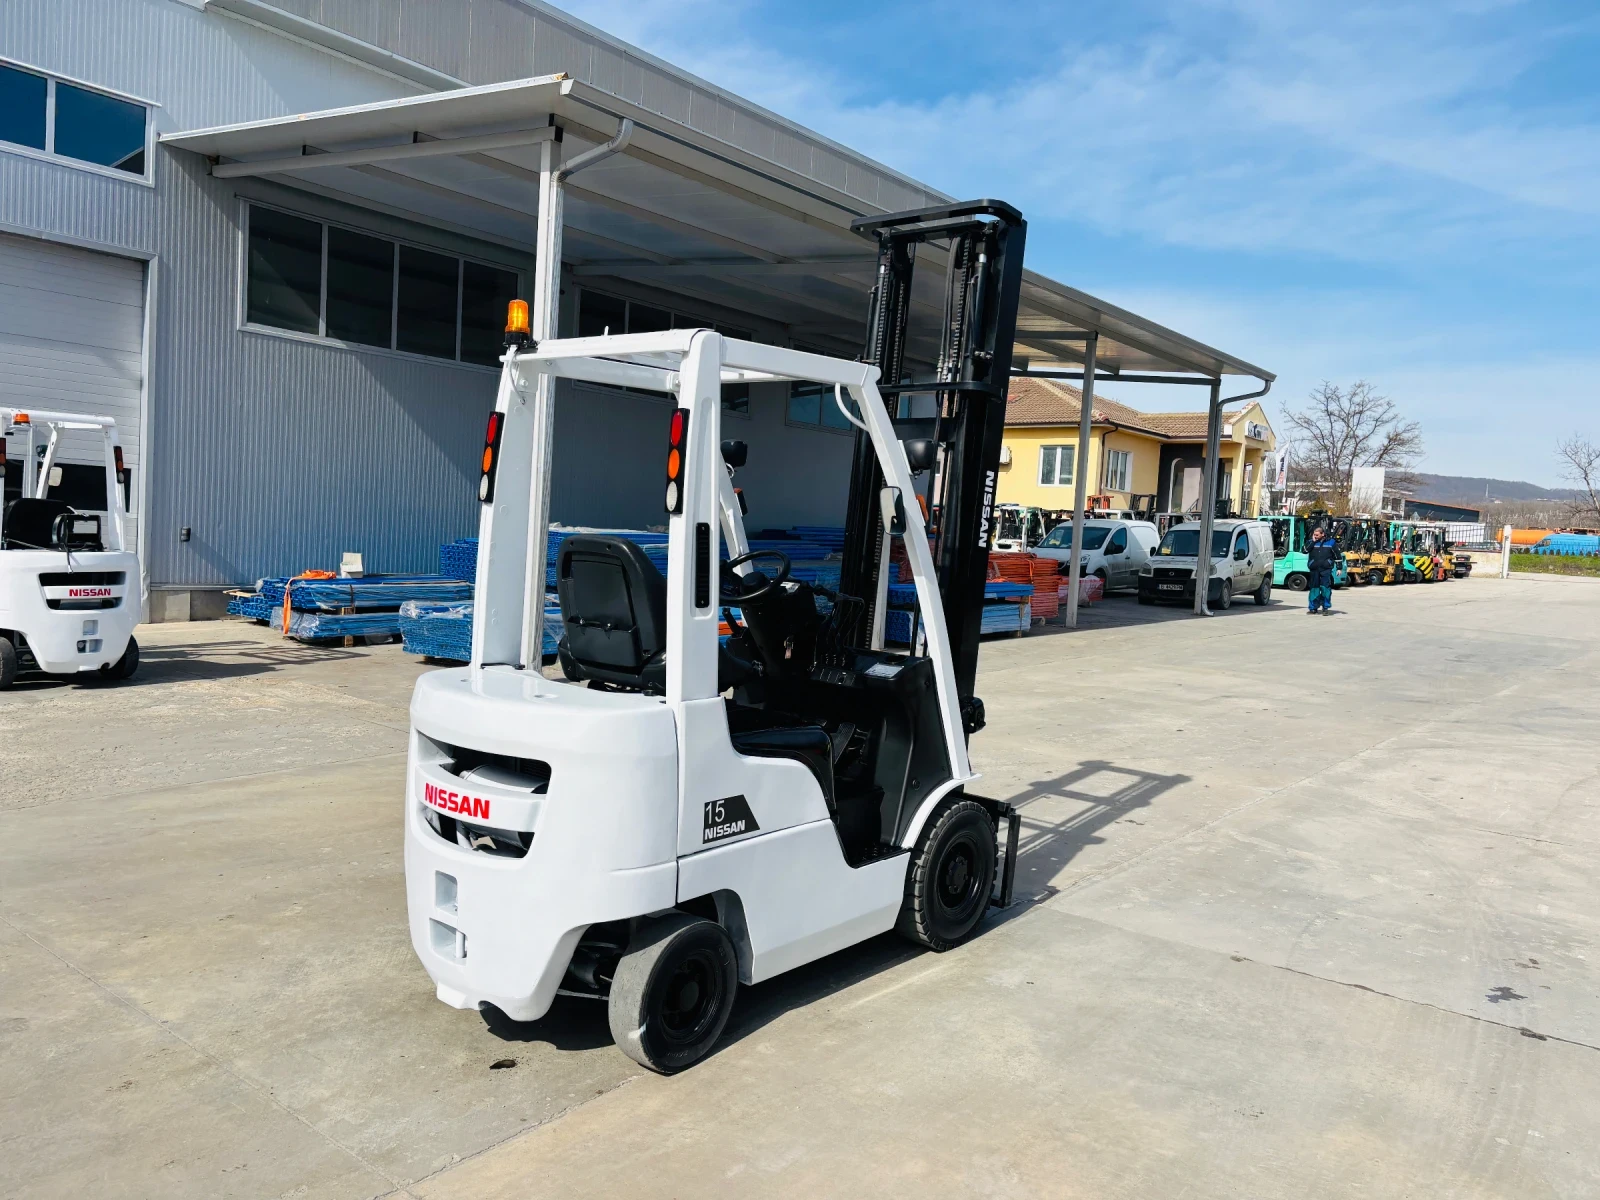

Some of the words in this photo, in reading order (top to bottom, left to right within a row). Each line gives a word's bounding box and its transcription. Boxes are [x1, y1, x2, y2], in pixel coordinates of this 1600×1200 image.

[978, 470, 995, 548] NISSAN
[69, 588, 111, 597] NISSAN
[424, 782, 490, 820] NISSAN
[705, 800, 725, 825] 15
[704, 819, 746, 841] NISSAN
